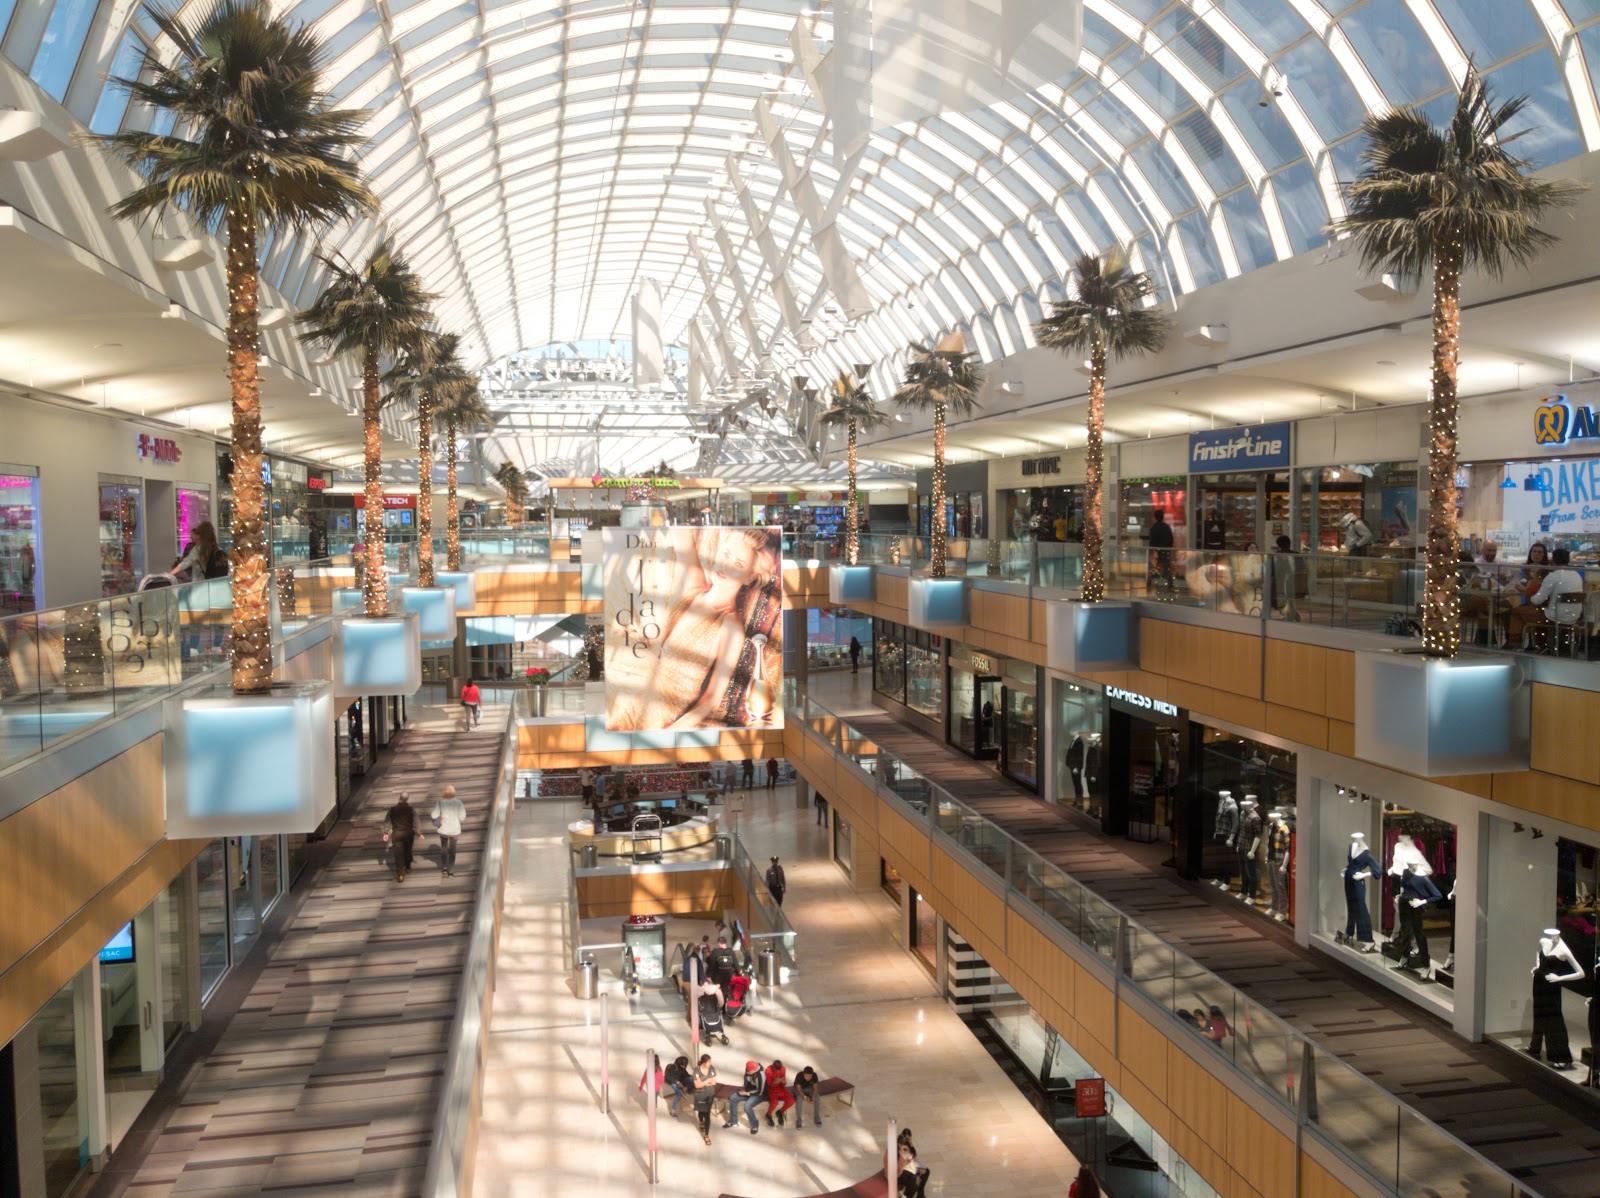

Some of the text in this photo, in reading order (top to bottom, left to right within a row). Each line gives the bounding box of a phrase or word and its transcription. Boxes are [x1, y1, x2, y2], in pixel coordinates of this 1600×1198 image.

[1549, 508, 1577, 526] From
[626, 534, 657, 549] Dior
[972, 655, 990, 671] FOSSIL
[1106, 685, 1178, 717] EXPRESS MEN
